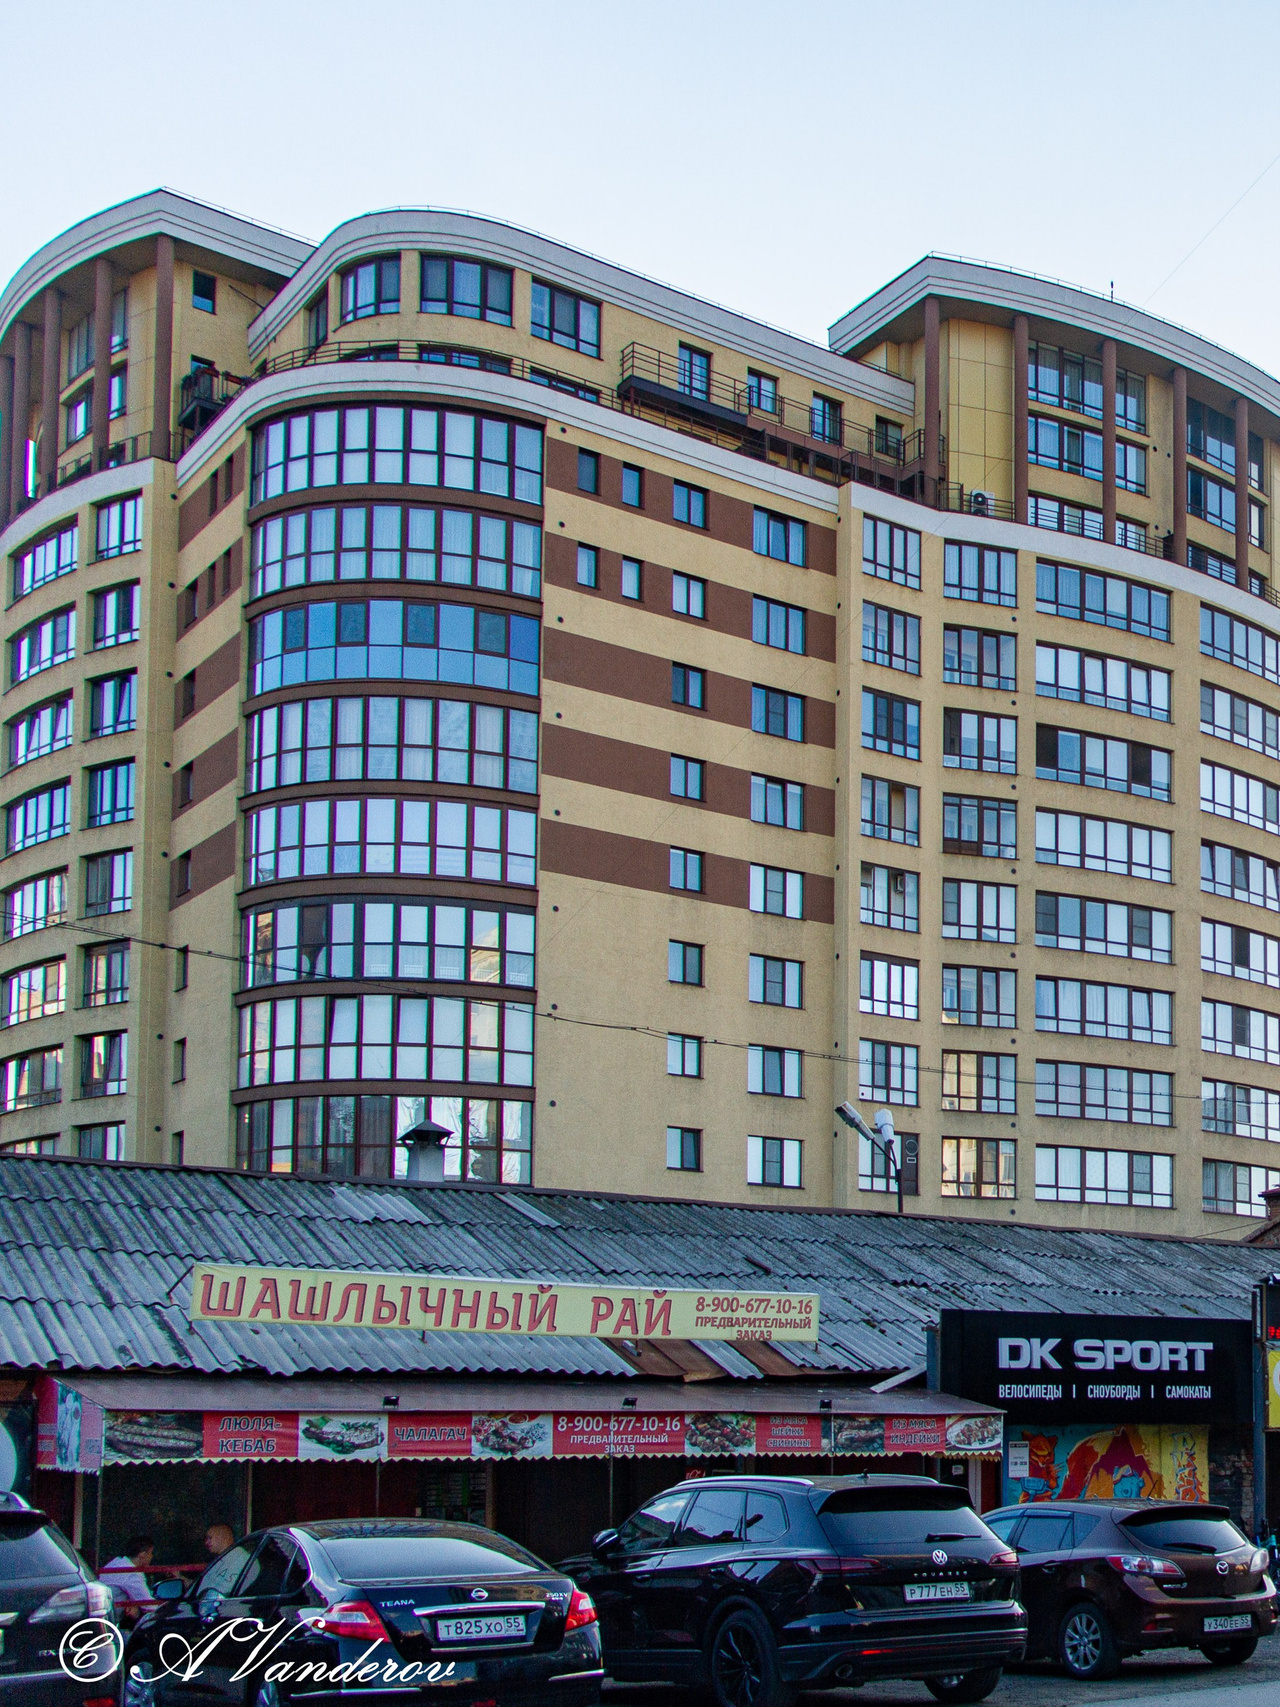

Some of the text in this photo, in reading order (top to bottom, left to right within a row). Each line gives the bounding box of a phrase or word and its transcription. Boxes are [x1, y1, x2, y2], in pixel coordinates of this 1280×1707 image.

[199, 1274, 673, 1336] ШАШЛЫЧНЫЙ РАЙ
[695, 1296, 813, 1314] 8-900-677-10-16
[695, 1316, 812, 1329] ПРЕДВАРИТЕЛЬНЫЙ
[735, 1330, 773, 1341] ЗАКАЗ
[998, 1338, 1213, 1371] DK SPORT
[999, 1384, 1212, 1400] ВЕЛОСИПЕДЫ СНОУБОРДЫ САМОКАТЫ
[219, 1416, 282, 1431] ЛЮЛЯ-
[557, 1416, 681, 1432] 8-900-677-10-16
[770, 1416, 808, 1425] ИЗ МЯСА
[892, 1418, 937, 1430] ИЗ МЯСА
[394, 1427, 467, 1441] ЧАЛАГАЧ
[771, 1426, 805, 1436] ШЕЙКИ
[766, 1438, 811, 1448] СВИНИНЫ
[890, 1431, 941, 1446] ИНДЕЙКИ
[219, 1438, 277, 1453] КЕБАБ
[604, 1444, 635, 1453] ЗАКАЗ
[380, 1598, 415, 1608] TEANA
[506, 1617, 521, 1628] 55
